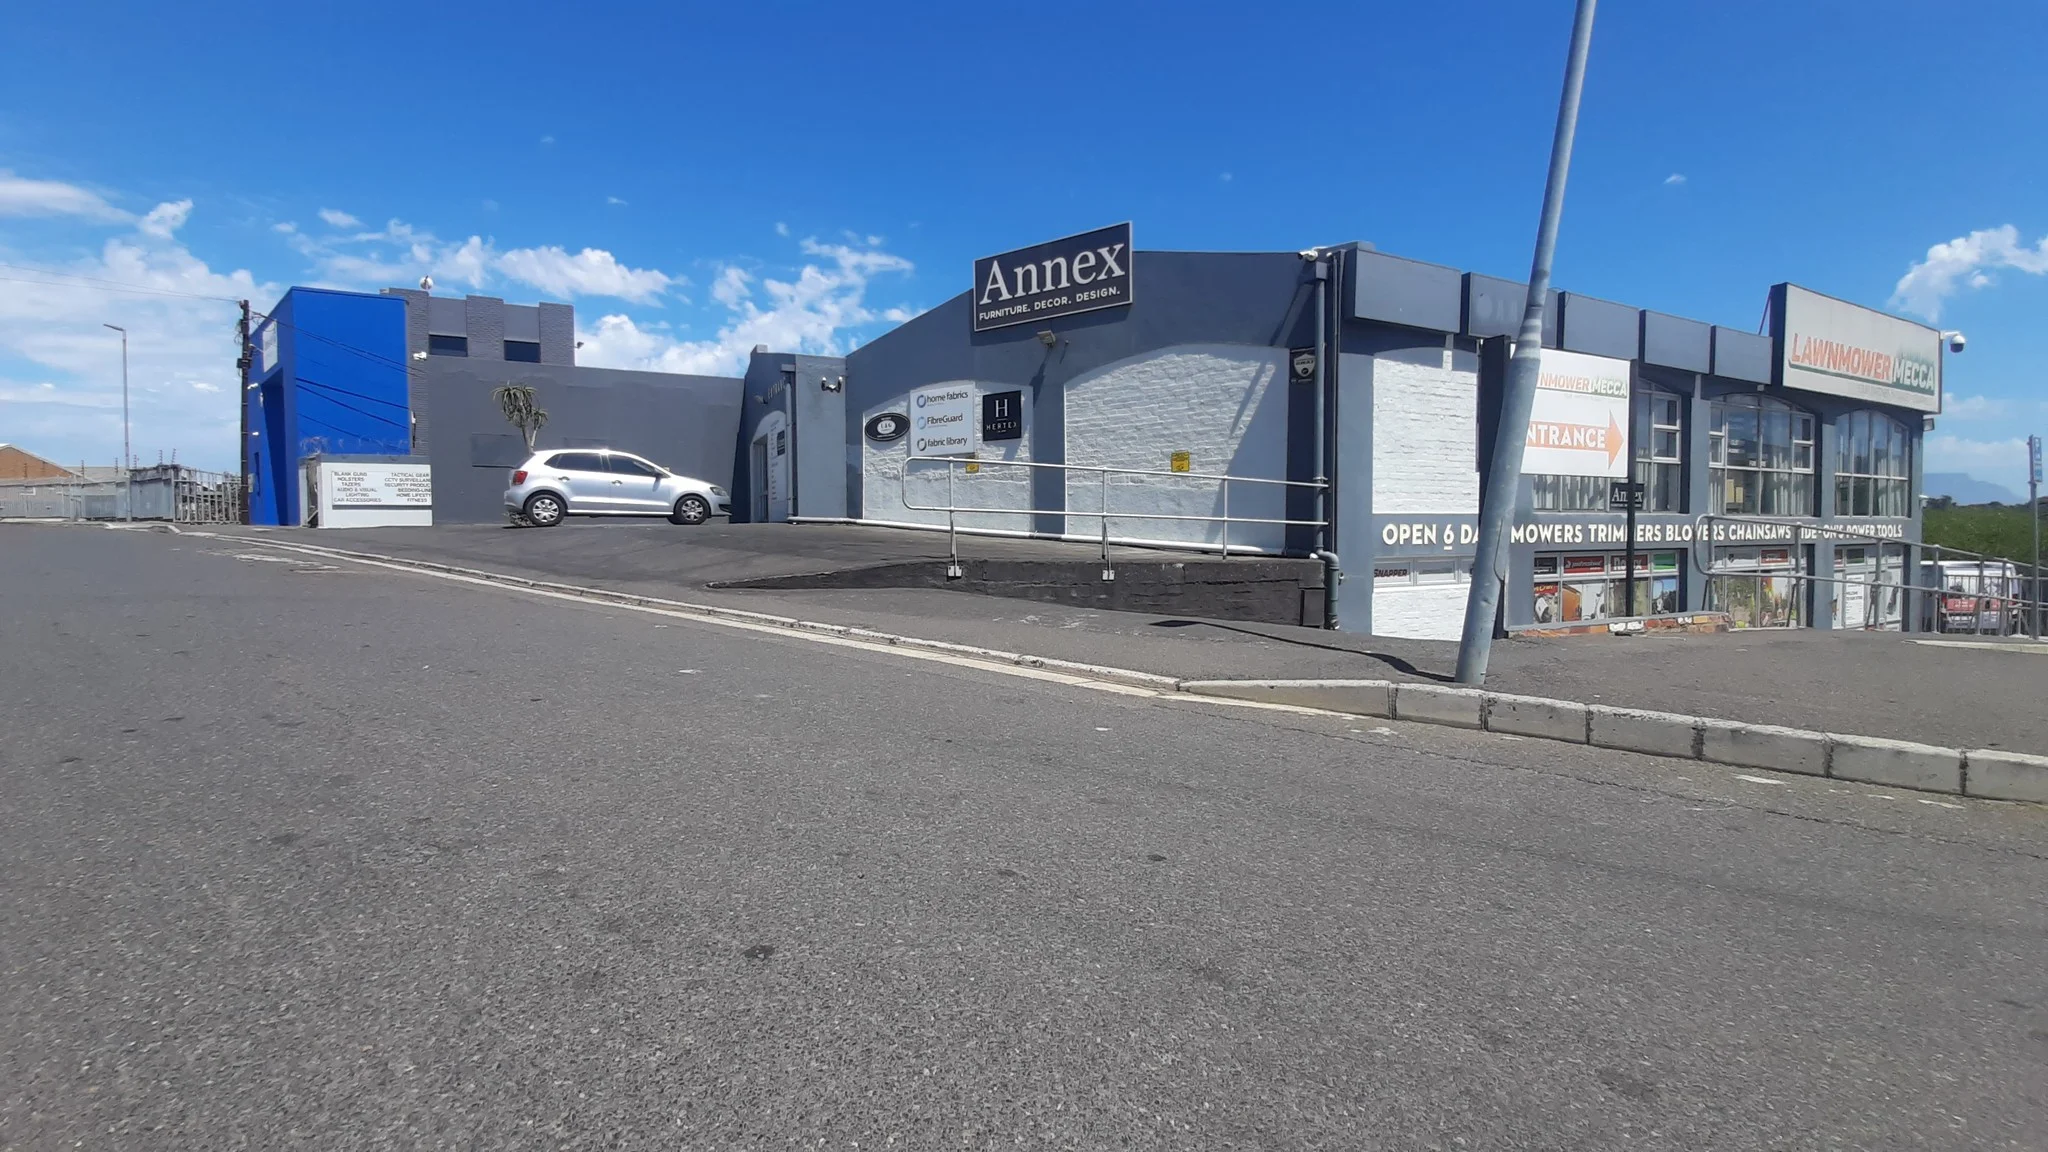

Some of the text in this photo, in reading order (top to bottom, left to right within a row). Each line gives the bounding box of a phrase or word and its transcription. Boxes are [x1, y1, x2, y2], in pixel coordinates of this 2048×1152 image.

[979, 243, 1125, 305] Annex
[979, 286, 1121, 321] FURNITURE. DECOR. DESIGN.
[1791, 332, 1935, 390] LAWNMOWER MECCA
[1540, 372, 1627, 396] NMOWER MECCA
[926, 391, 969, 403] home fabrics
[1527, 424, 1606, 449] NTRANCE
[1382, 523, 1437, 545] OPEN
[1443, 523, 1455, 546] 6
[1510, 523, 1583, 544] MOWERS
[1588, 523, 1661, 543] TRIMERS
[1728, 524, 1792, 541] CHAINSAWS
[1373, 568, 1408, 578] SNAPPER
